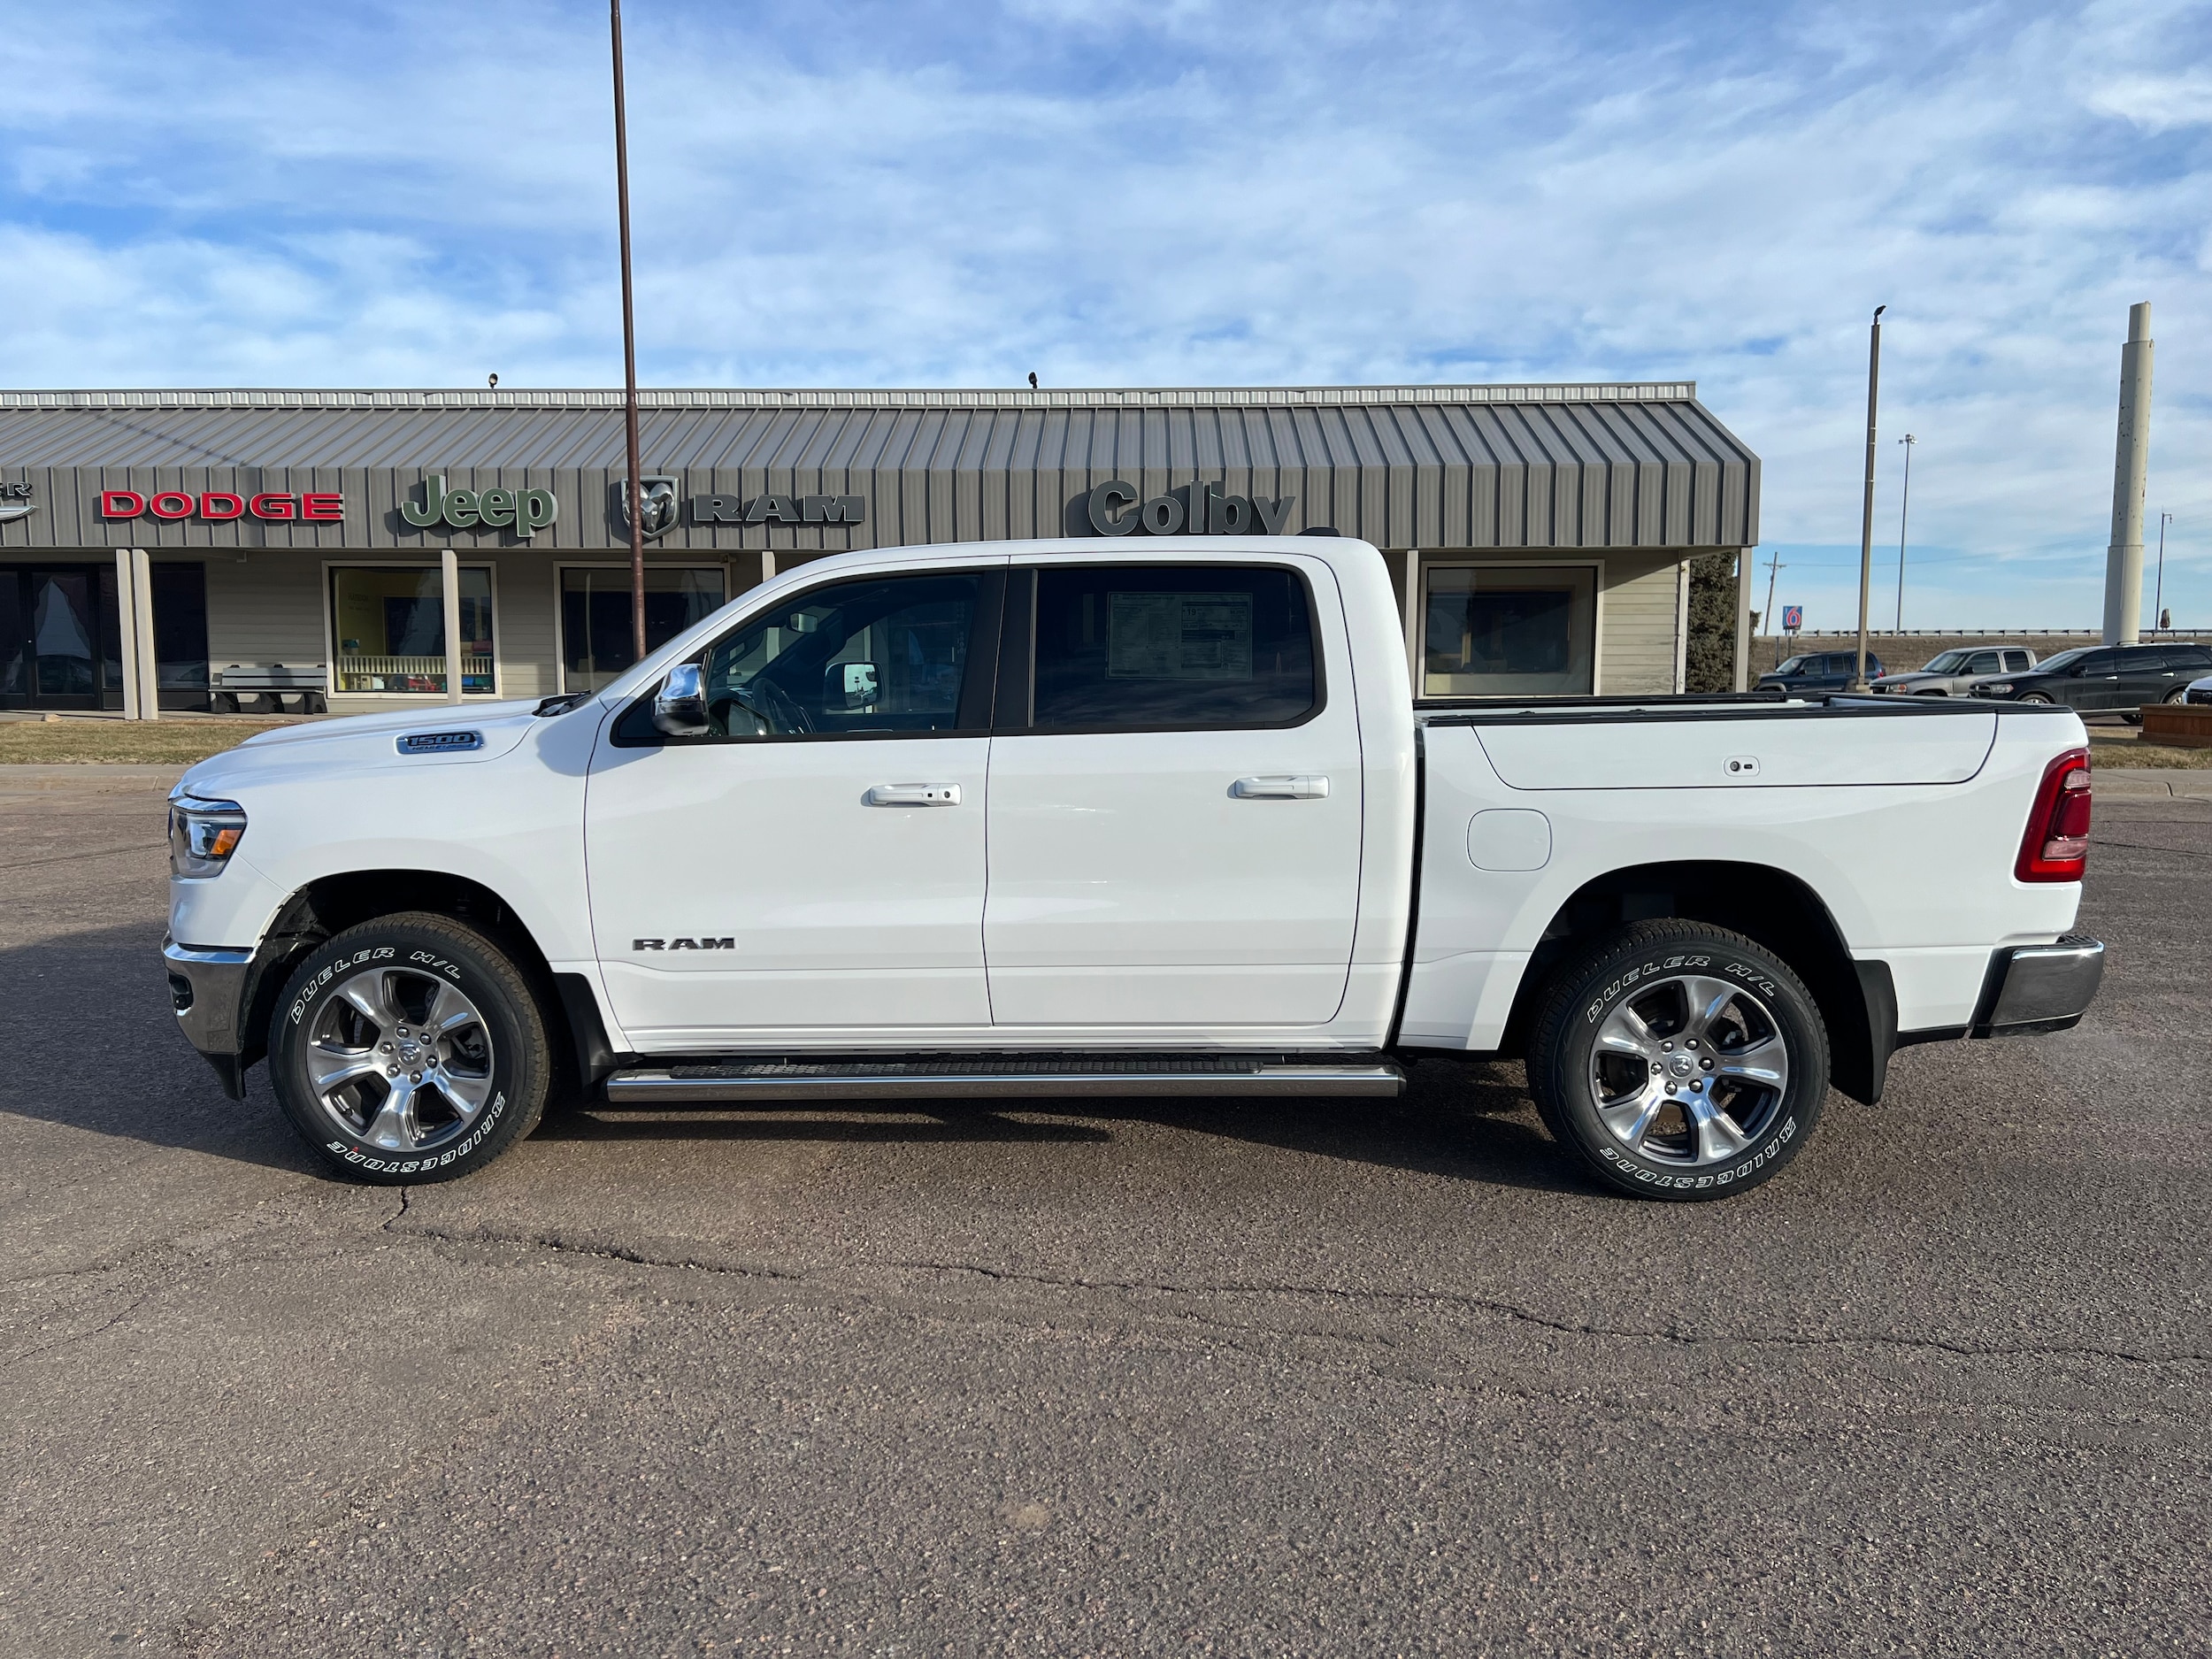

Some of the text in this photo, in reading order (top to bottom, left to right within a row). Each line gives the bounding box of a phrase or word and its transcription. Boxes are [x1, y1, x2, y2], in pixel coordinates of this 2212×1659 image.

[101, 490, 344, 520] DODGE
[402, 474, 559, 538] Jeep
[694, 494, 864, 522] RAM
[1088, 480, 1296, 536] Colby
[1786, 606, 1801, 626] 6
[410, 733, 472, 747] 1500
[633, 938, 735, 951] RAM
[290, 947, 461, 1025] DUELER H/L
[1586, 955, 1775, 1024] DUELER H/L
[326, 1091, 506, 1173] BRIDGESTONE
[1600, 1116, 1797, 1189] BRIDGESTONE
